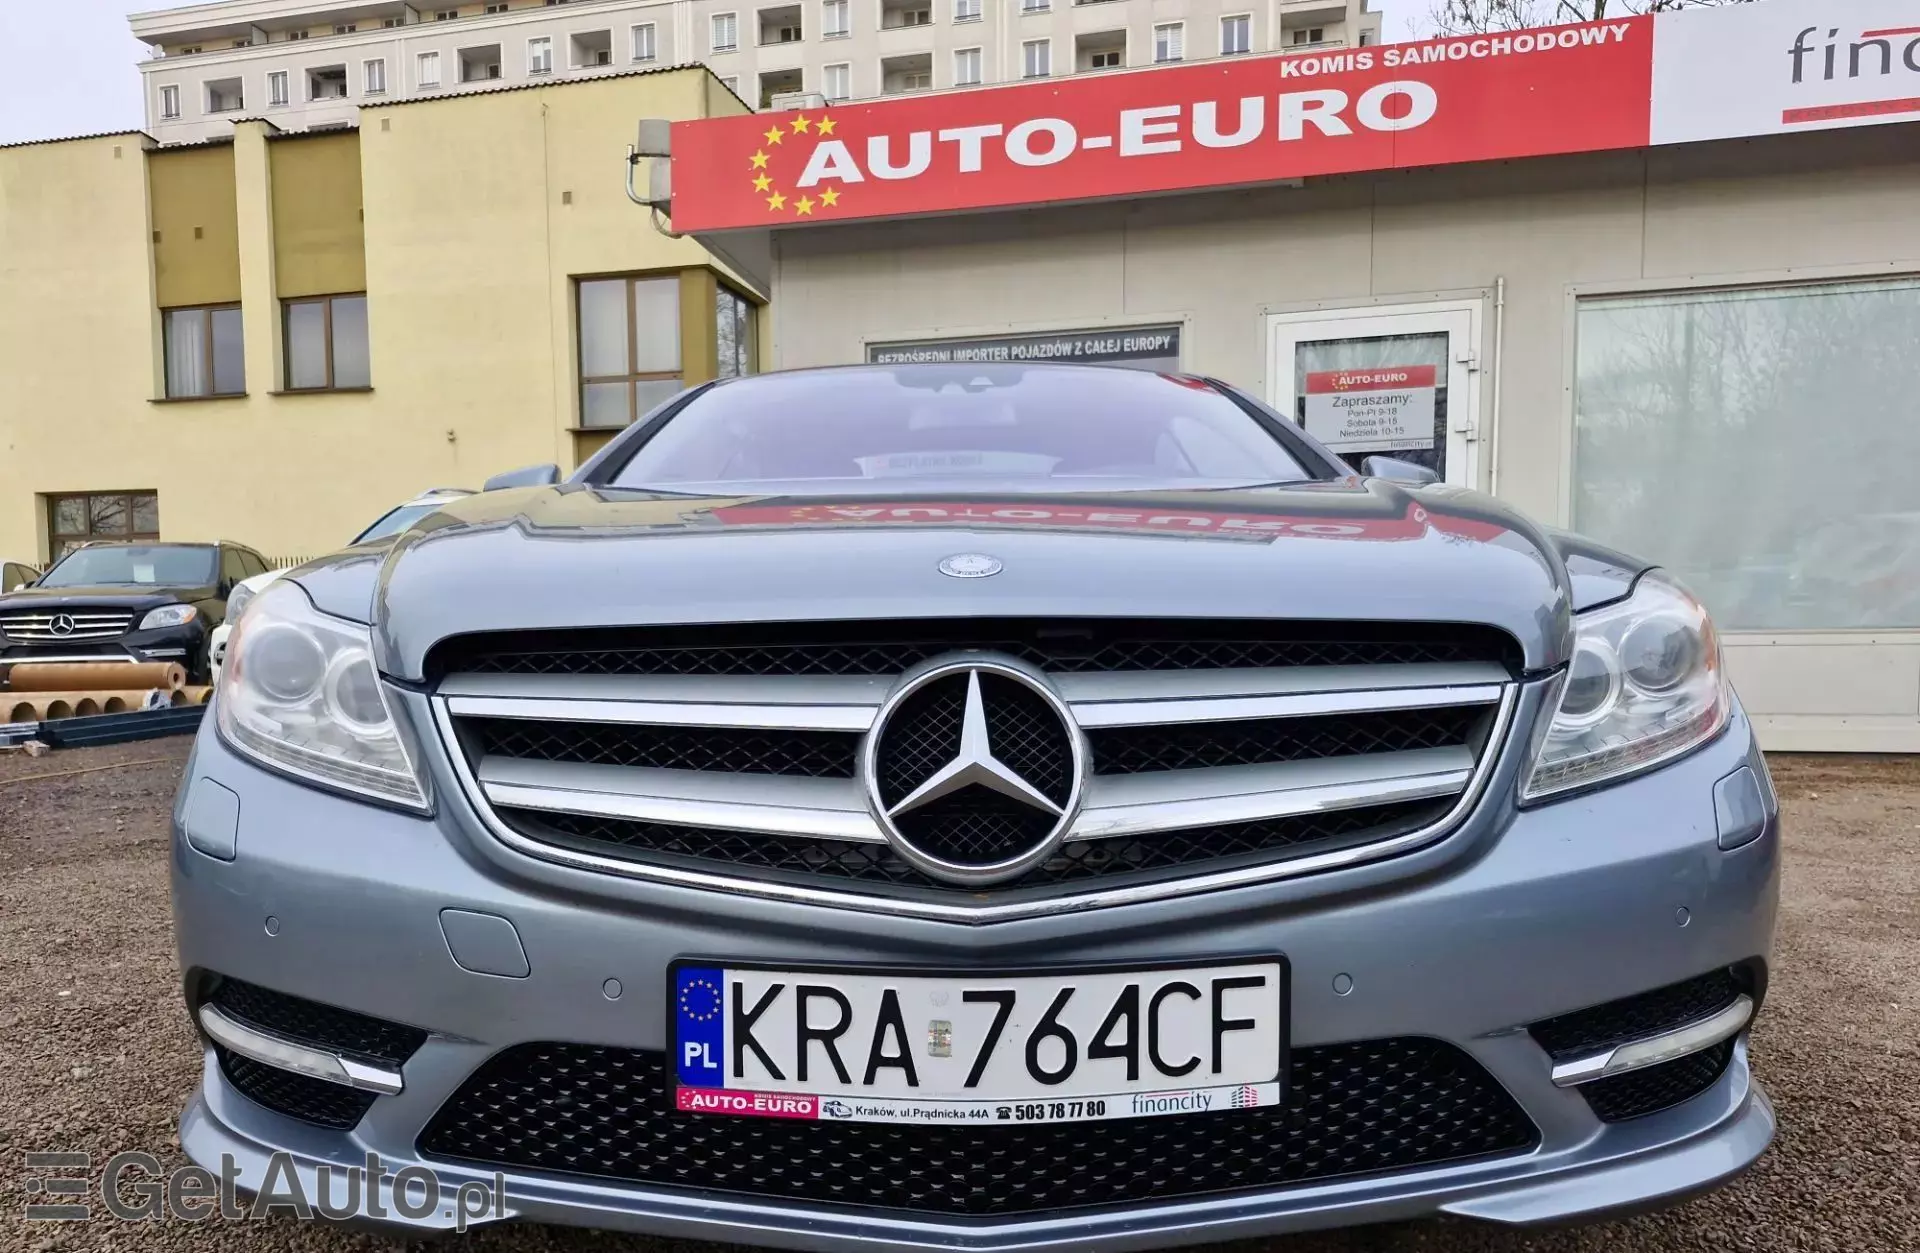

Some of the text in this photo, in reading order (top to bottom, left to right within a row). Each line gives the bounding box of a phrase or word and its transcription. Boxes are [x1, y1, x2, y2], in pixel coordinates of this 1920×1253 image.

[1280, 23, 1631, 79] KOMIS SAMOCHODOWY
[796, 80, 1438, 188] AUTO-EURO
[953, 347, 1009, 361] IMPORTER
[1011, 339, 1072, 360] POJAZDÓW
[1074, 342, 1082, 355] Z
[1085, 339, 1120, 354] CAŁEJ
[1123, 335, 1171, 352] EUROPY
[1339, 372, 1408, 385] AUTO-EURO
[1332, 393, 1413, 408] Zapraszamy:
[731, 974, 1267, 1089] KRA 764CF
[684, 1041, 718, 1069] PL
[690, 1094, 812, 1114] AUTO-EURO
[855, 1105, 989, 1120] Kraków, ul.Prądnicka 44A
[1015, 1100, 1106, 1121] 503 78 77 80
[1132, 1091, 1213, 1113] financity
